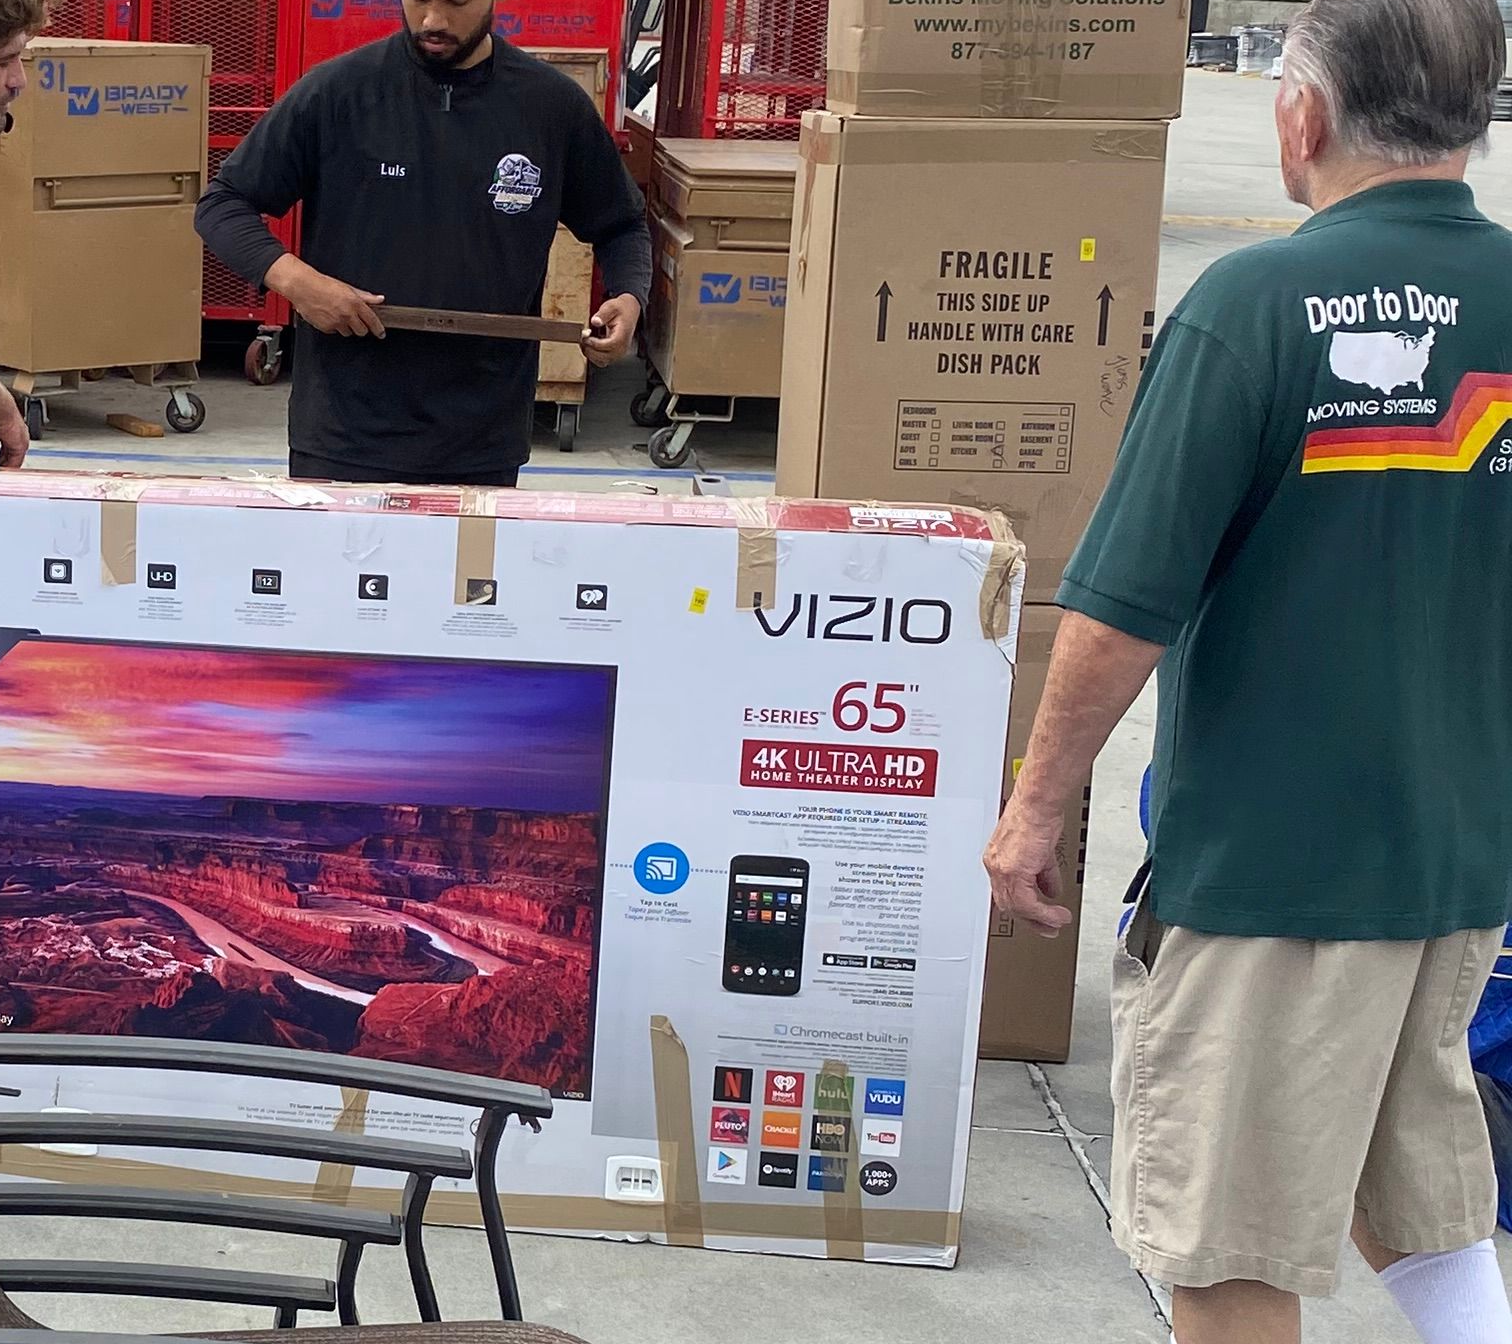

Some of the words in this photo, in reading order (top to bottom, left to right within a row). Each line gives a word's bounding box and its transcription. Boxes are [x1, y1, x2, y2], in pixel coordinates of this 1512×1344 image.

[528, 15, 597, 26] BRADY
[914, 15, 1136, 37] www.mybekins.com
[39, 59, 65, 93] 31
[103, 85, 188, 102] BRADY
[119, 102, 170, 115] WEST
[380, 162, 407, 177] Luis
[939, 251, 1054, 280] FRAGILE
[937, 293, 976, 312] THIS
[981, 293, 1022, 313] SIDE
[1027, 294, 1050, 313] UP
[1304, 293, 1368, 334] Door
[1372, 286, 1402, 322] to
[1404, 284, 1460, 326] Door
[907, 322, 976, 341] HANDLE
[981, 323, 1025, 342] WITH
[1031, 324, 1075, 343] CARE
[937, 353, 983, 374] DISH
[990, 354, 1041, 375] PACK
[1306, 399, 1380, 423] MOVING
[1383, 398, 1438, 415] SYSTEMS
[851, 516, 958, 531] VIZIO
[753, 592, 952, 645] VIZIO
[752, 748, 788, 770] 4K
[794, 750, 878, 775] ULTRA
[884, 755, 926, 777] HD
[750, 770, 792, 782] HOME
[797, 773, 859, 787] THEATER
[864, 776, 924, 790] DISPLAY
[752, 810, 792, 819] SMARTCAST
[793, 812, 807, 820] APP
[807, 813, 842, 822] REQUIRED
[858, 816, 880, 824] SETUP
[818, 807, 843, 815] PHONE
[853, 808, 872, 816] YOUR
[874, 810, 897, 818] SMART
[867, 862, 892, 870] mobile
[885, 879, 896, 887] big
[790, 1025, 864, 1042] Chromecast
[866, 1032, 909, 1045] built-in
[817, 1086, 848, 1099] hulu
[869, 1093, 902, 1105] VUDU
[816, 1122, 846, 1136] HBO
[814, 1134, 843, 1145] NOW
[773, 1166, 794, 1176] Spotify
[865, 1178, 890, 1188] APPS
